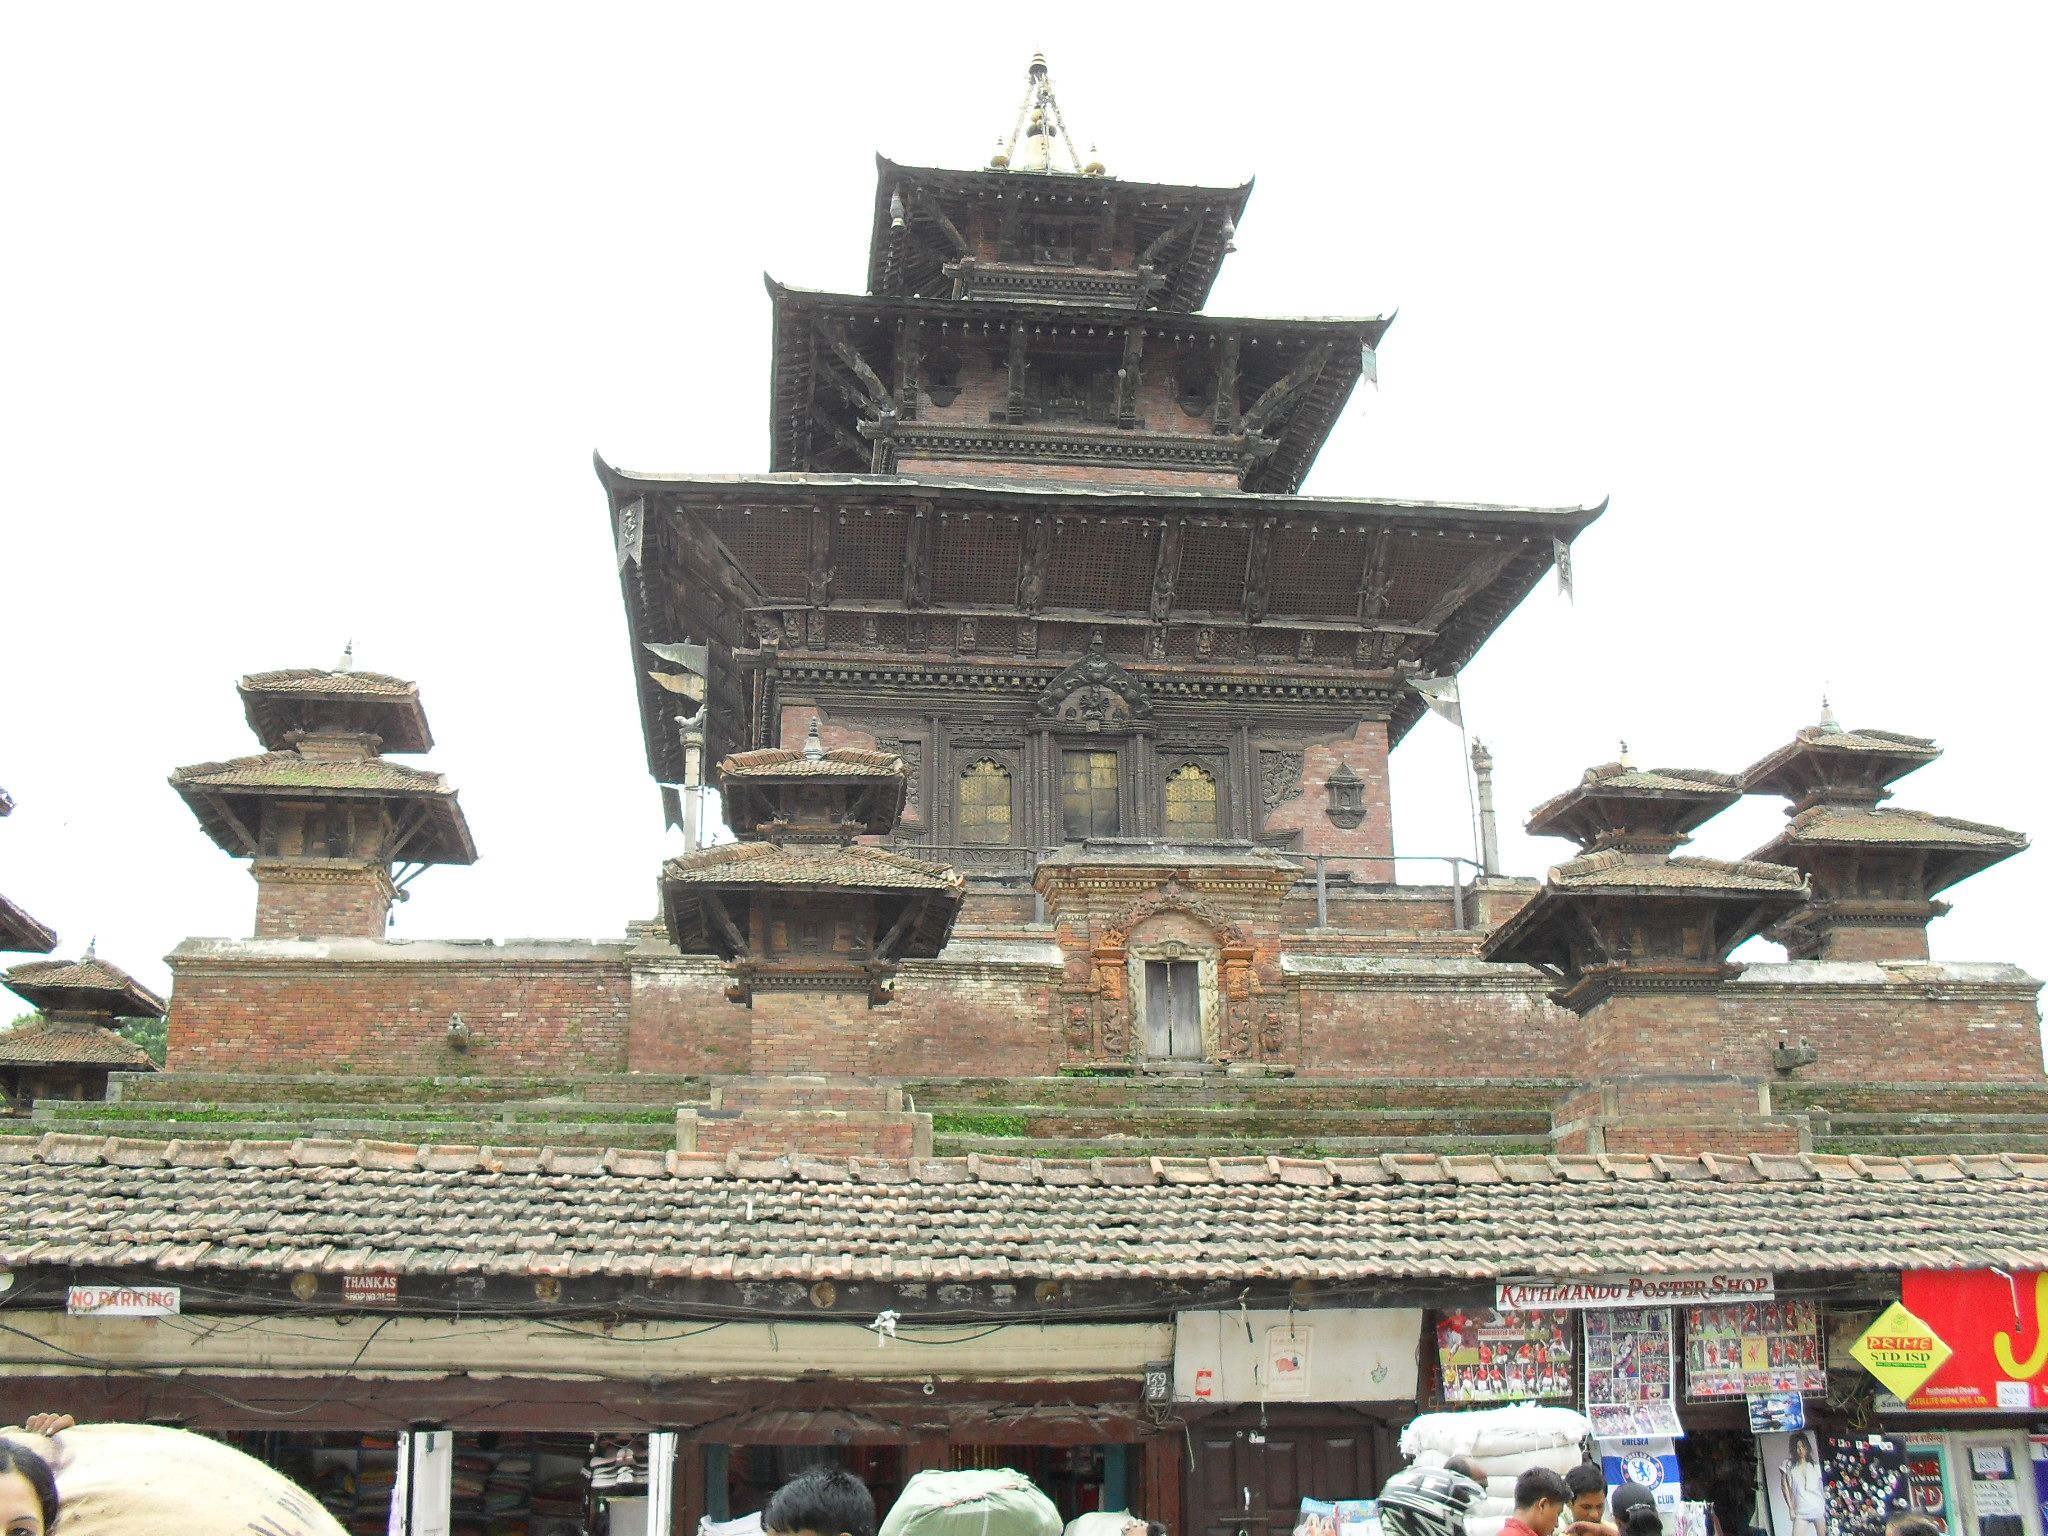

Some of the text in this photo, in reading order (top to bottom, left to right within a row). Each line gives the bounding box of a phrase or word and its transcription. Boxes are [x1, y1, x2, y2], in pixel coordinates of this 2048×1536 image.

[343, 1276, 397, 1289] THANKAS
[1500, 1275, 1769, 1308] KATHMANDU POSTER SHOP
[72, 1291, 176, 1307] NO PARKING
[1869, 1337, 1931, 1350] PRIME
[1870, 1351, 1931, 1363] STD ISD
[1146, 1372, 1167, 1387] 139
[1149, 1387, 1166, 1398] 37
[1621, 1437, 1649, 1446] CHELSEA
[1657, 1494, 1675, 1505] CLUB
